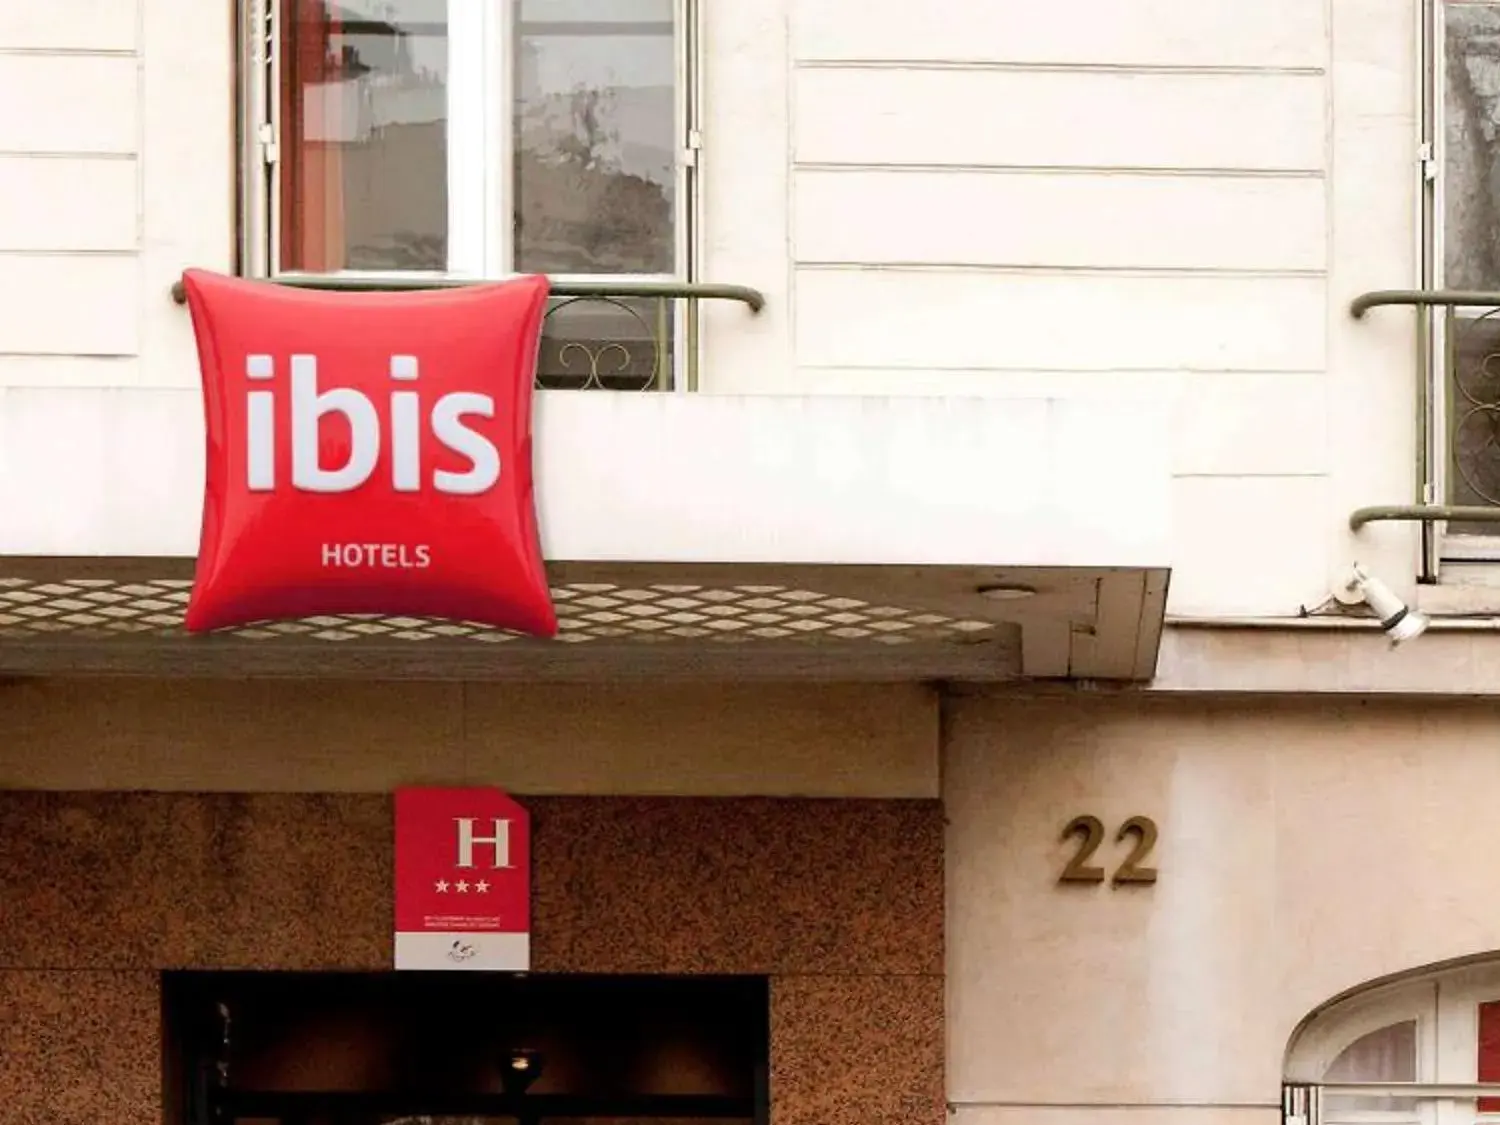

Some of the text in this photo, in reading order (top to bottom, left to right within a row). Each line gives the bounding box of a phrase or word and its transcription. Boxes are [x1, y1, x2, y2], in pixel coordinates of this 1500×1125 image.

[246, 354, 501, 494] ibis
[321, 543, 431, 568] HOTELS
[452, 817, 517, 869] H
[1058, 815, 1158, 886] 22
